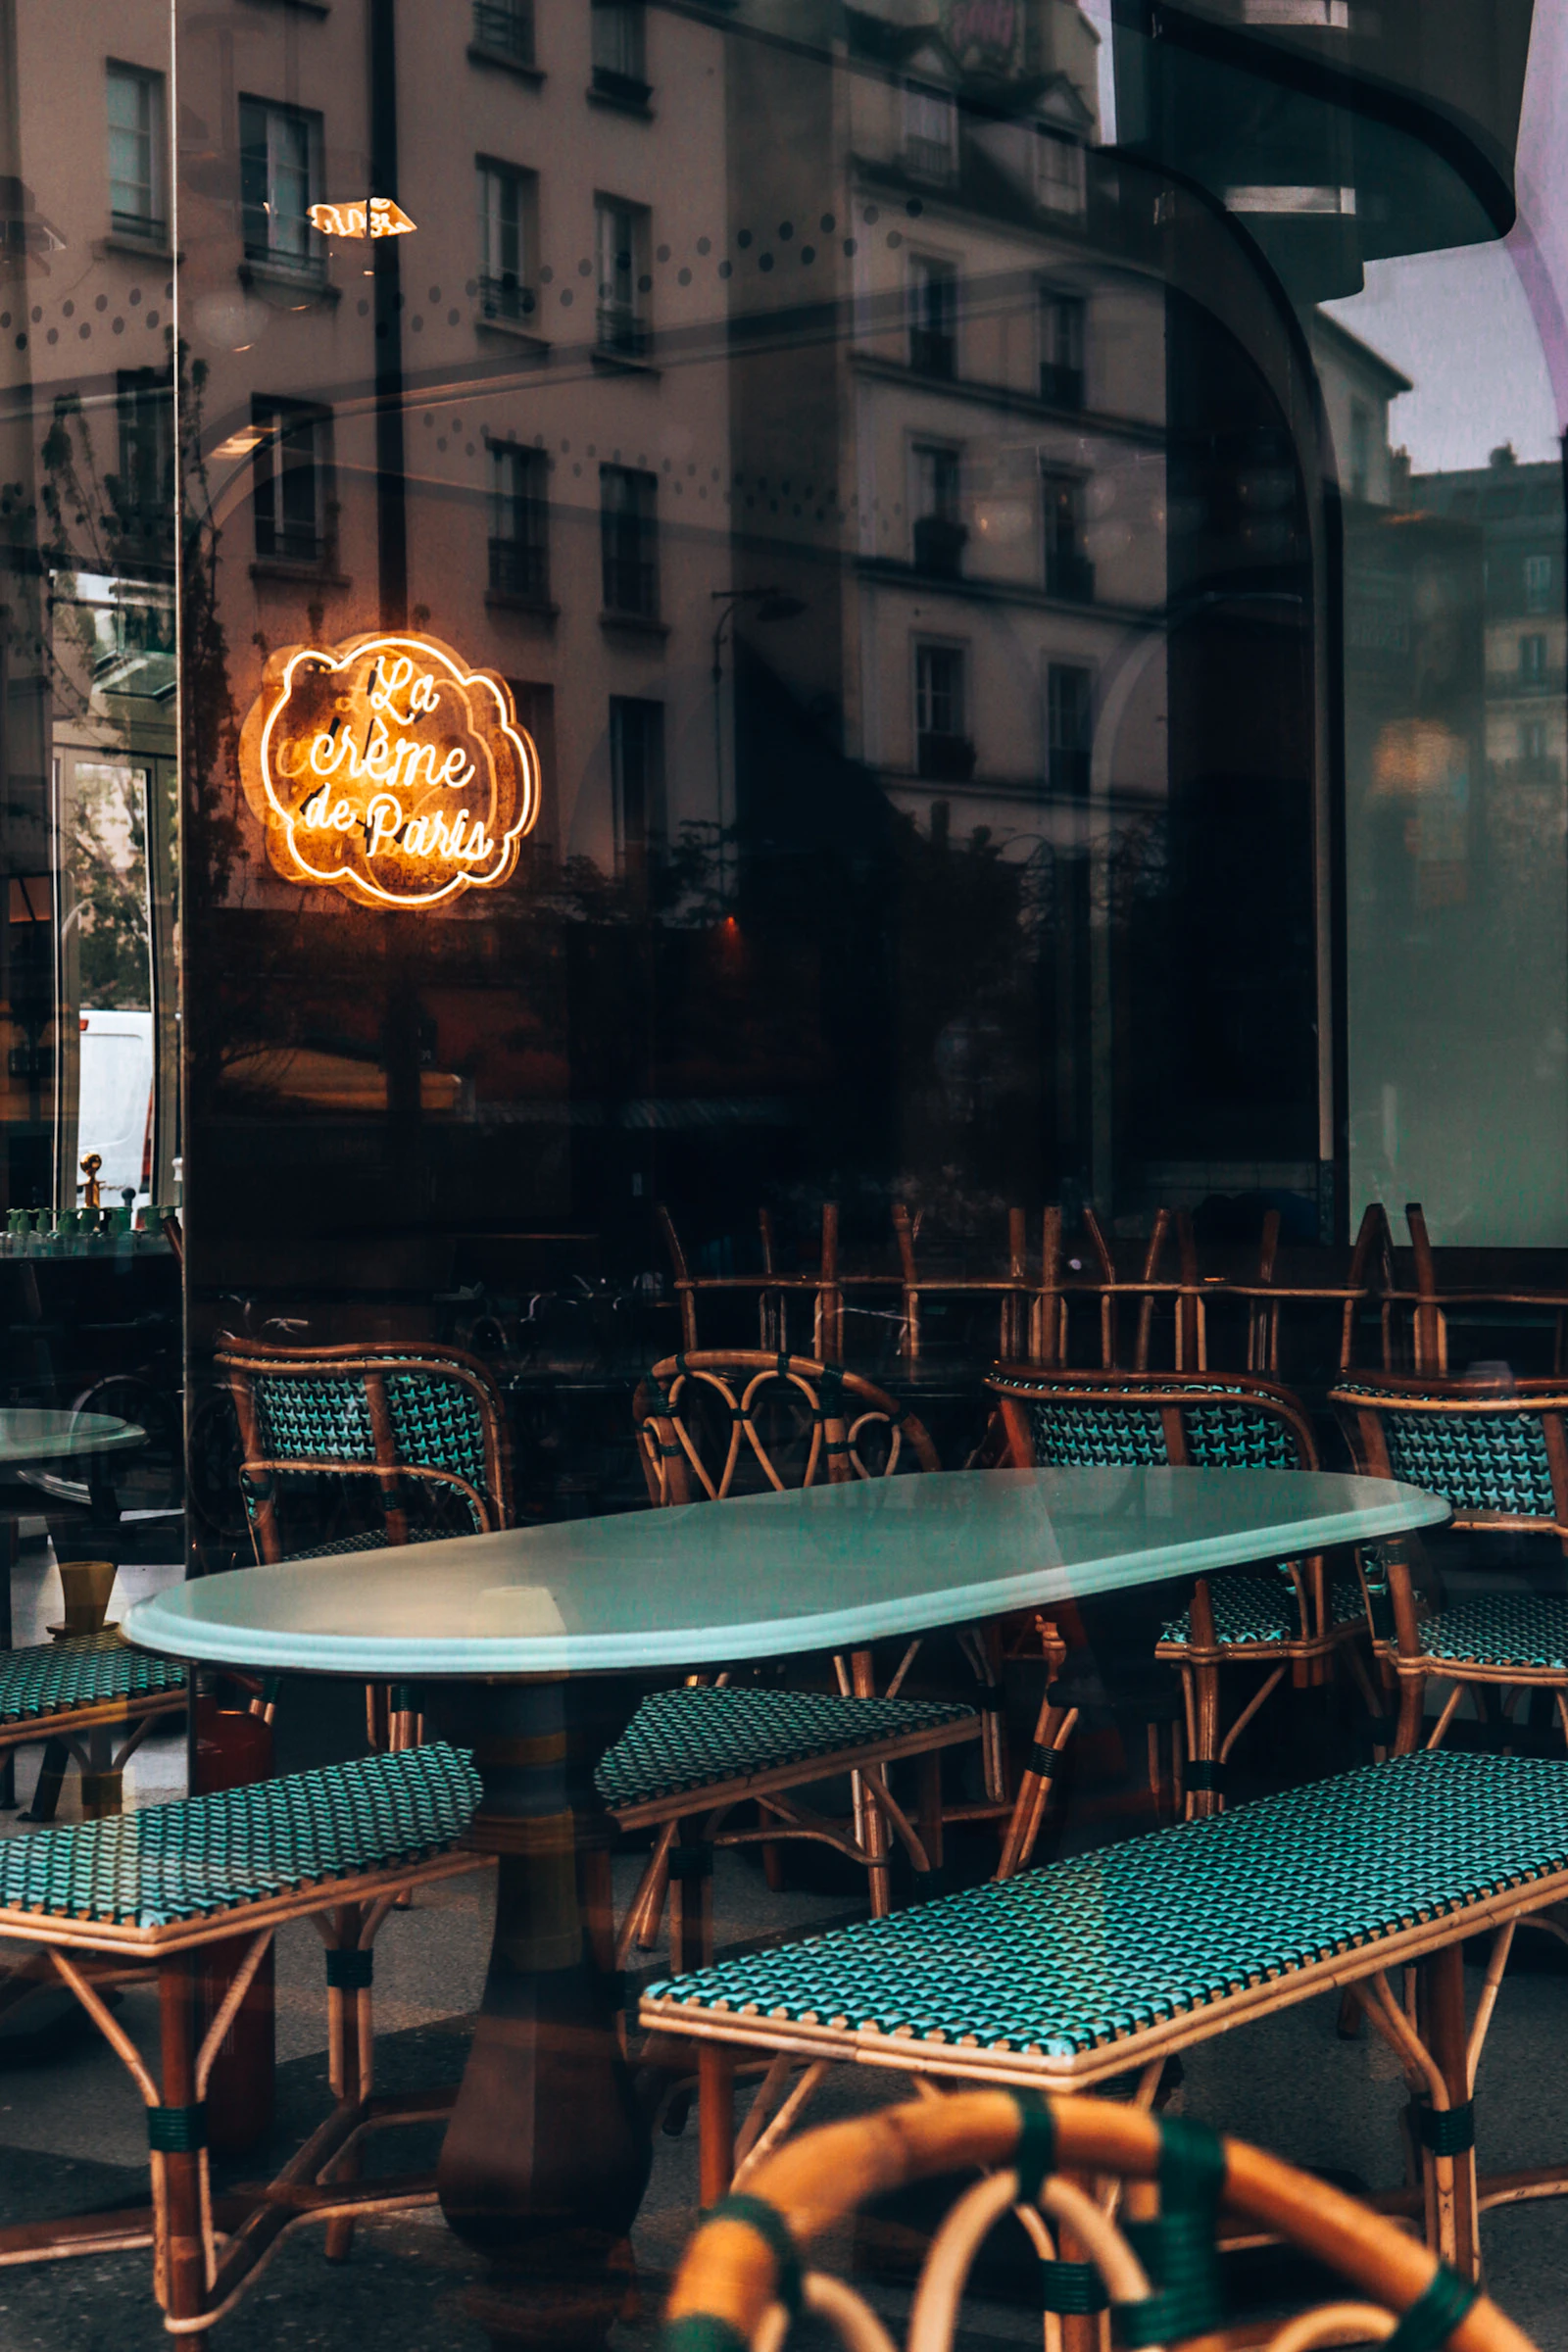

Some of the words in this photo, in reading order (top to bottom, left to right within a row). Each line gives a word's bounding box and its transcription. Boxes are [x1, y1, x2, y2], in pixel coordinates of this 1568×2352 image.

[370, 656, 440, 724] La
[310, 716, 475, 788] crème
[305, 782, 356, 830] de
[366, 793, 494, 860] Paris
